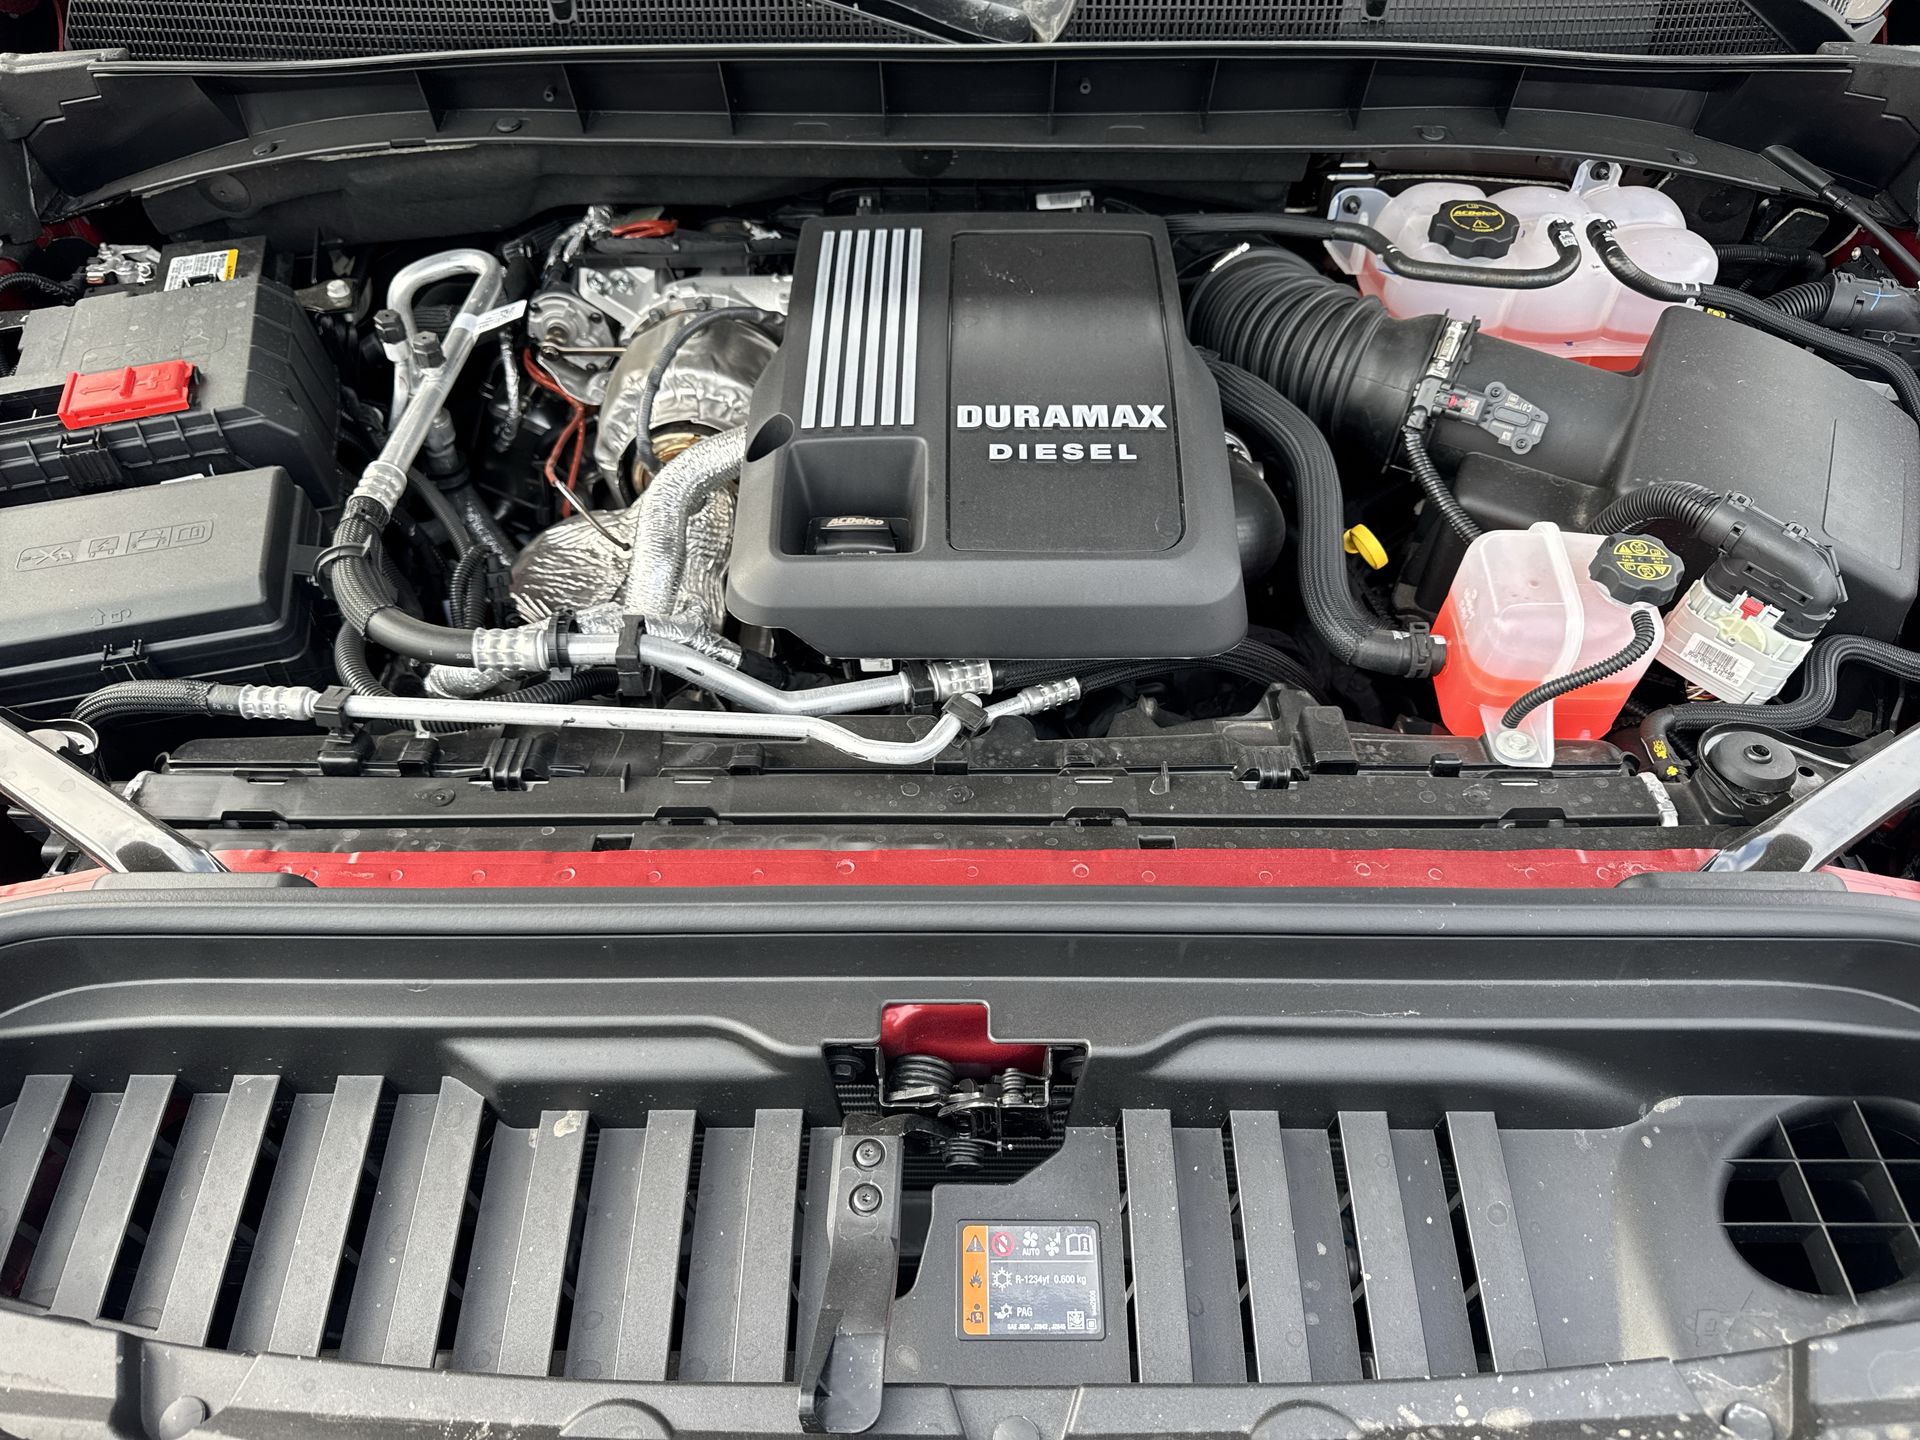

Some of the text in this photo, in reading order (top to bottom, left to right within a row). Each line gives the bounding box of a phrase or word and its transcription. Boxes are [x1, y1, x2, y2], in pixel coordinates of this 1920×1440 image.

[956, 404, 1168, 429] DURAMAX
[988, 443, 1138, 461] DIESEL
[826, 517, 885, 527] ACDelco
[1022, 1247, 1040, 1256] AUTO
[1053, 1274, 1075, 1284] 0.600
[1076, 1274, 1087, 1286] kg
[1016, 1306, 1033, 1317] PAG
